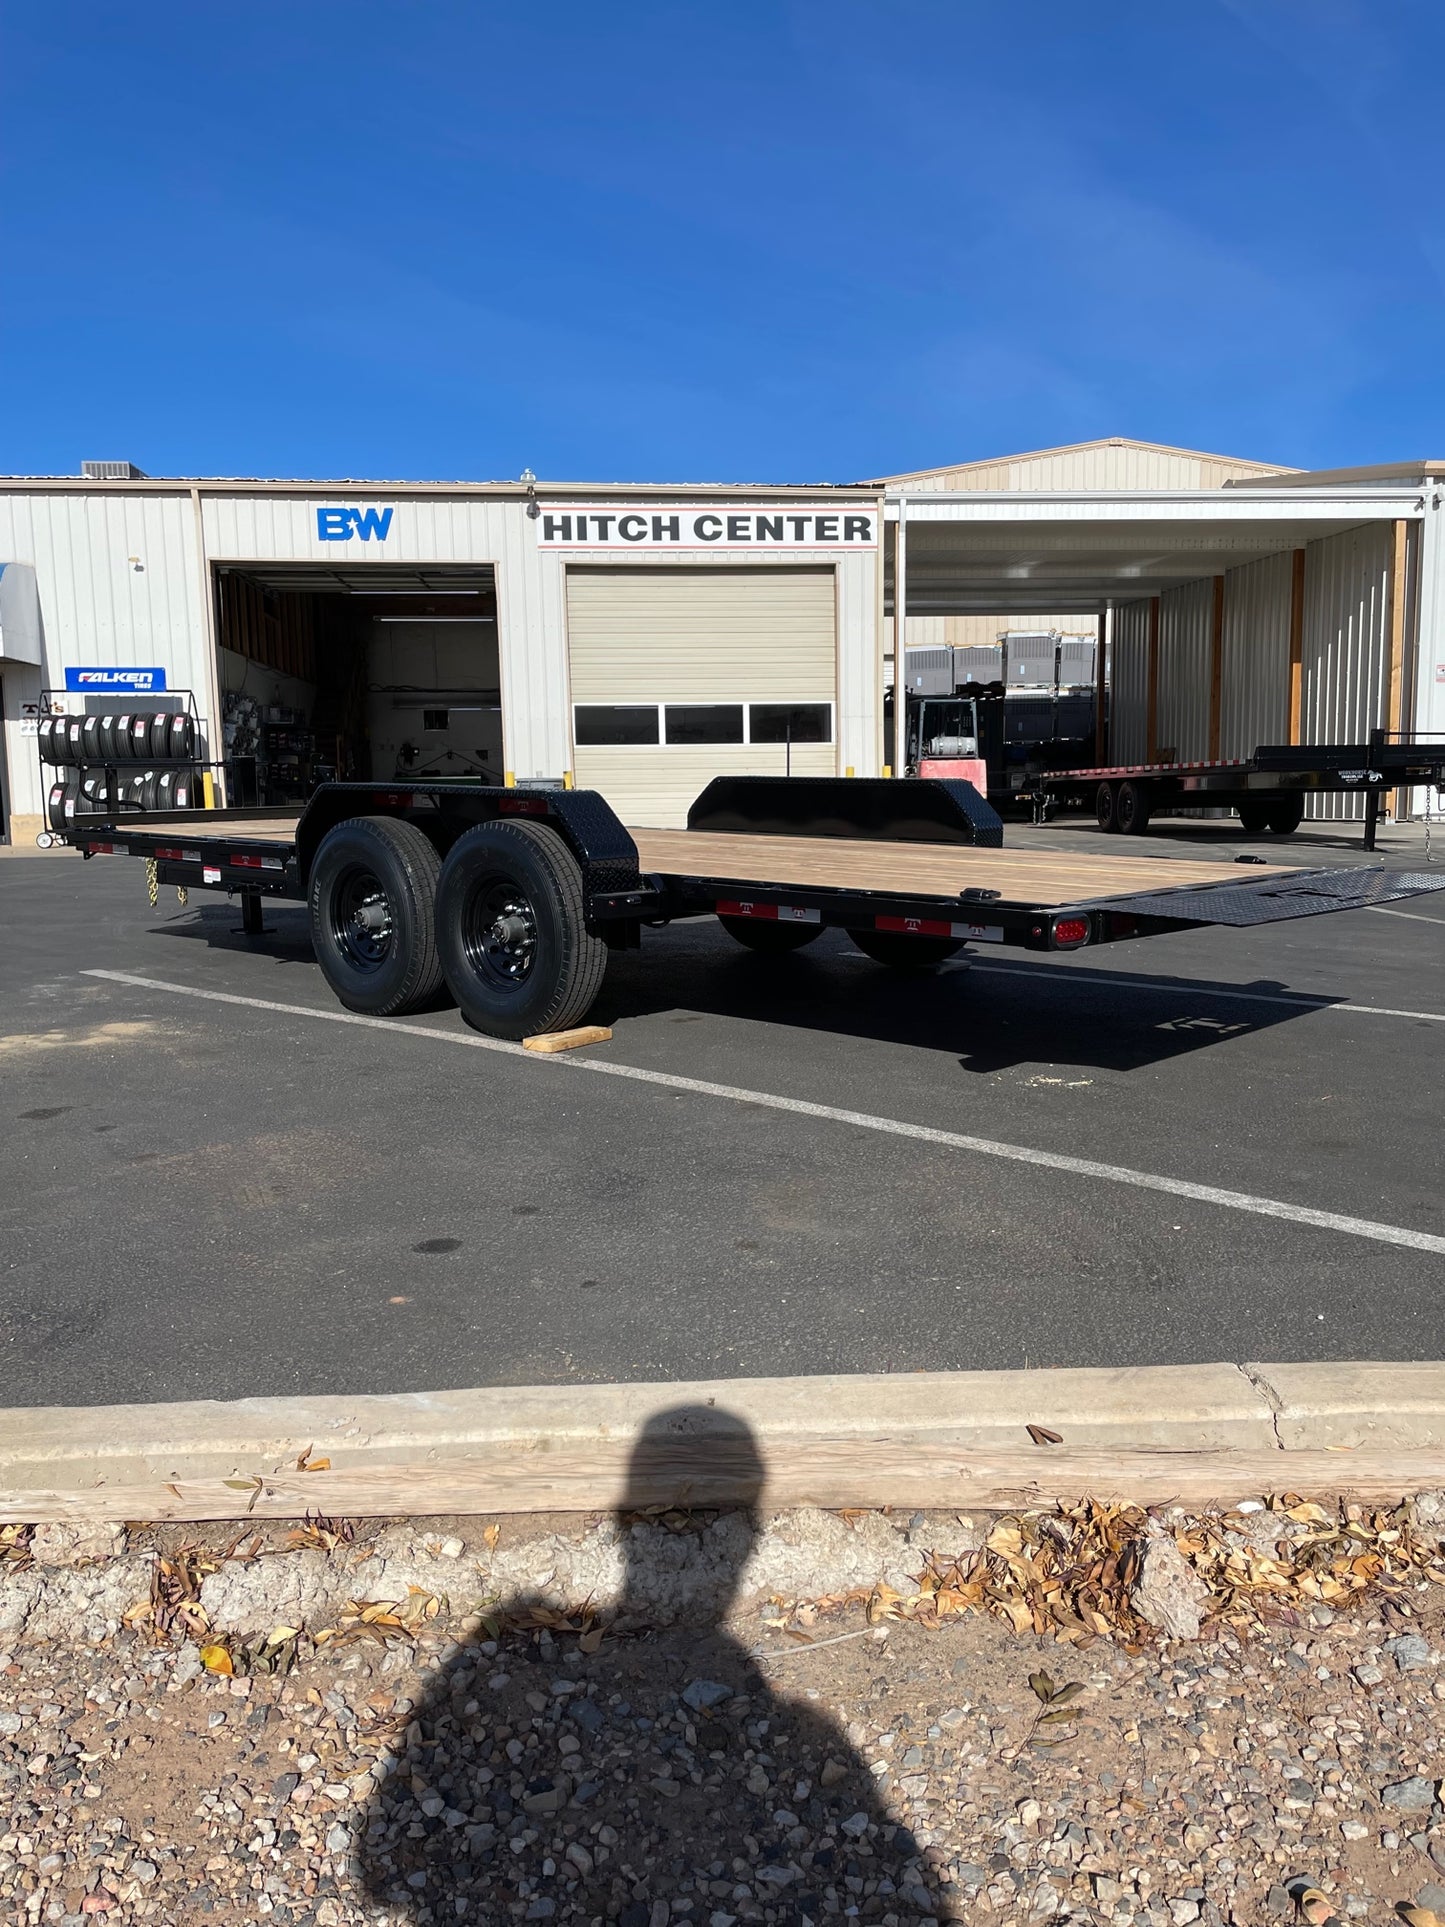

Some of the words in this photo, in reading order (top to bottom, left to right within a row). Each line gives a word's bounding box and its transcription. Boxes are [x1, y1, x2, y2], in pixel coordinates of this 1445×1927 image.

[543, 515, 680, 541] HITCH
[693, 514, 872, 541] CENTER
[78, 672, 153, 683] FALKEN
